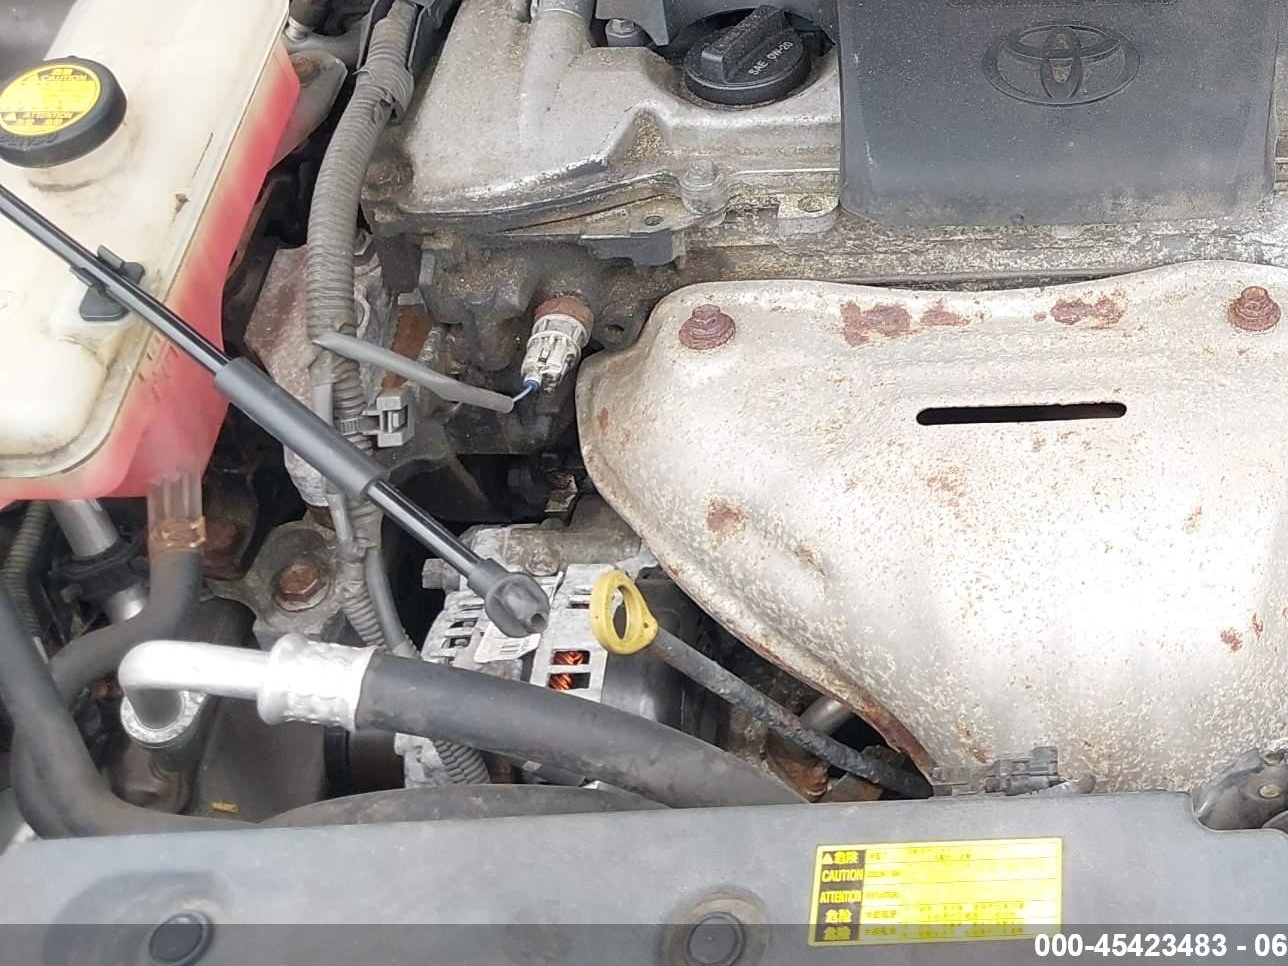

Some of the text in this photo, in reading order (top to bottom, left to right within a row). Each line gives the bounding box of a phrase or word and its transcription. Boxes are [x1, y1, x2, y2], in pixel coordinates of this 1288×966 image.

[748, 41, 794, 75] SAE 0W-20
[40, 74, 88, 82] CAUTION
[21, 111, 74, 119] ATTENTION
[821, 868, 864, 882] CAUTION
[819, 889, 862, 904] ATTENTION
